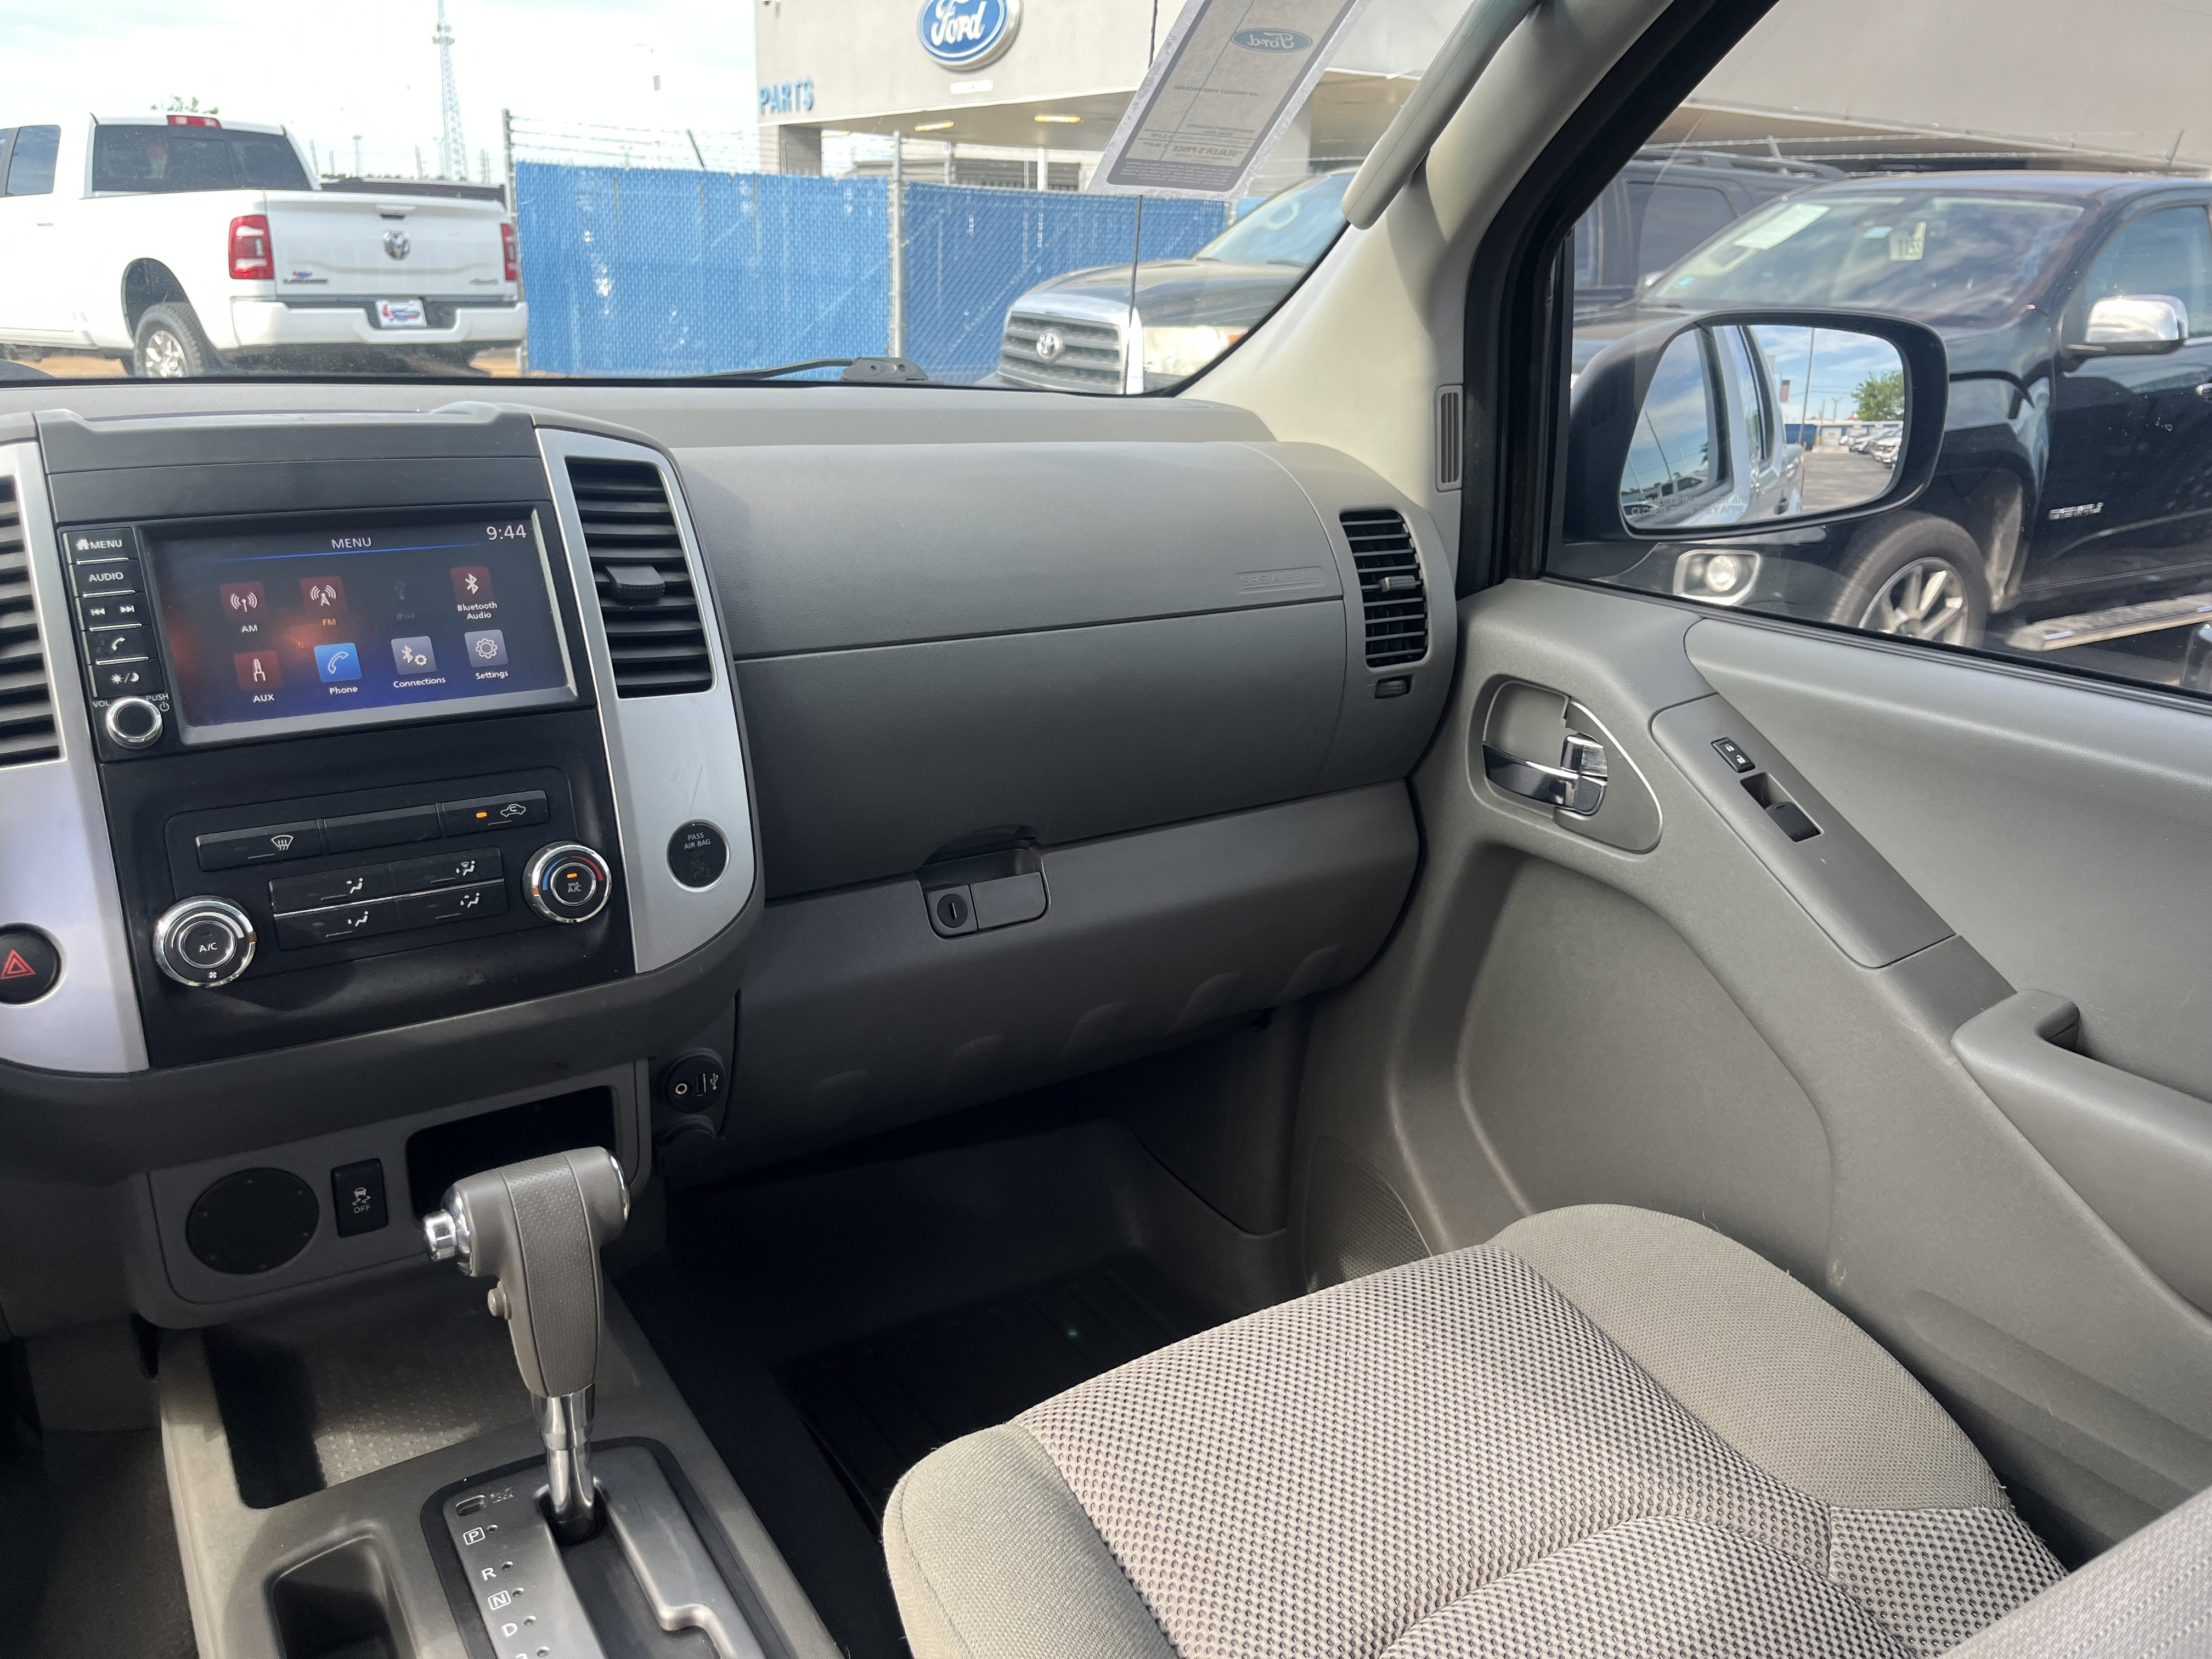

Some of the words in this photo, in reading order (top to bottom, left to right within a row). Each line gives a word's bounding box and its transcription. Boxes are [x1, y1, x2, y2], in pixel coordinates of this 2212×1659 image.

[930, 0, 986, 46] Ford
[759, 77, 814, 115] PARTS
[486, 524, 527, 540] 9:44
[89, 540, 123, 549] MENU
[331, 537, 372, 549] MENU
[88, 572, 124, 583] AUDIO
[457, 601, 498, 612] Bluetooth
[467, 612, 492, 620] Audio
[322, 618, 337, 627] FM
[241, 624, 258, 633] AM
[476, 670, 509, 680] Settings
[393, 677, 446, 688] Connections
[329, 686, 359, 695] Phone
[146, 693, 169, 702] PUSH
[253, 693, 275, 703] AUX
[92, 700, 110, 708] VOL
[687, 832, 704, 841] PASS
[697, 839, 711, 847] BAG
[199, 942, 218, 953] A/C
[353, 1204, 371, 1214] OFF
[469, 1531, 479, 1542] P
[482, 1567, 496, 1581] R
[492, 1595, 507, 1606] N
[502, 1623, 518, 1637] D
